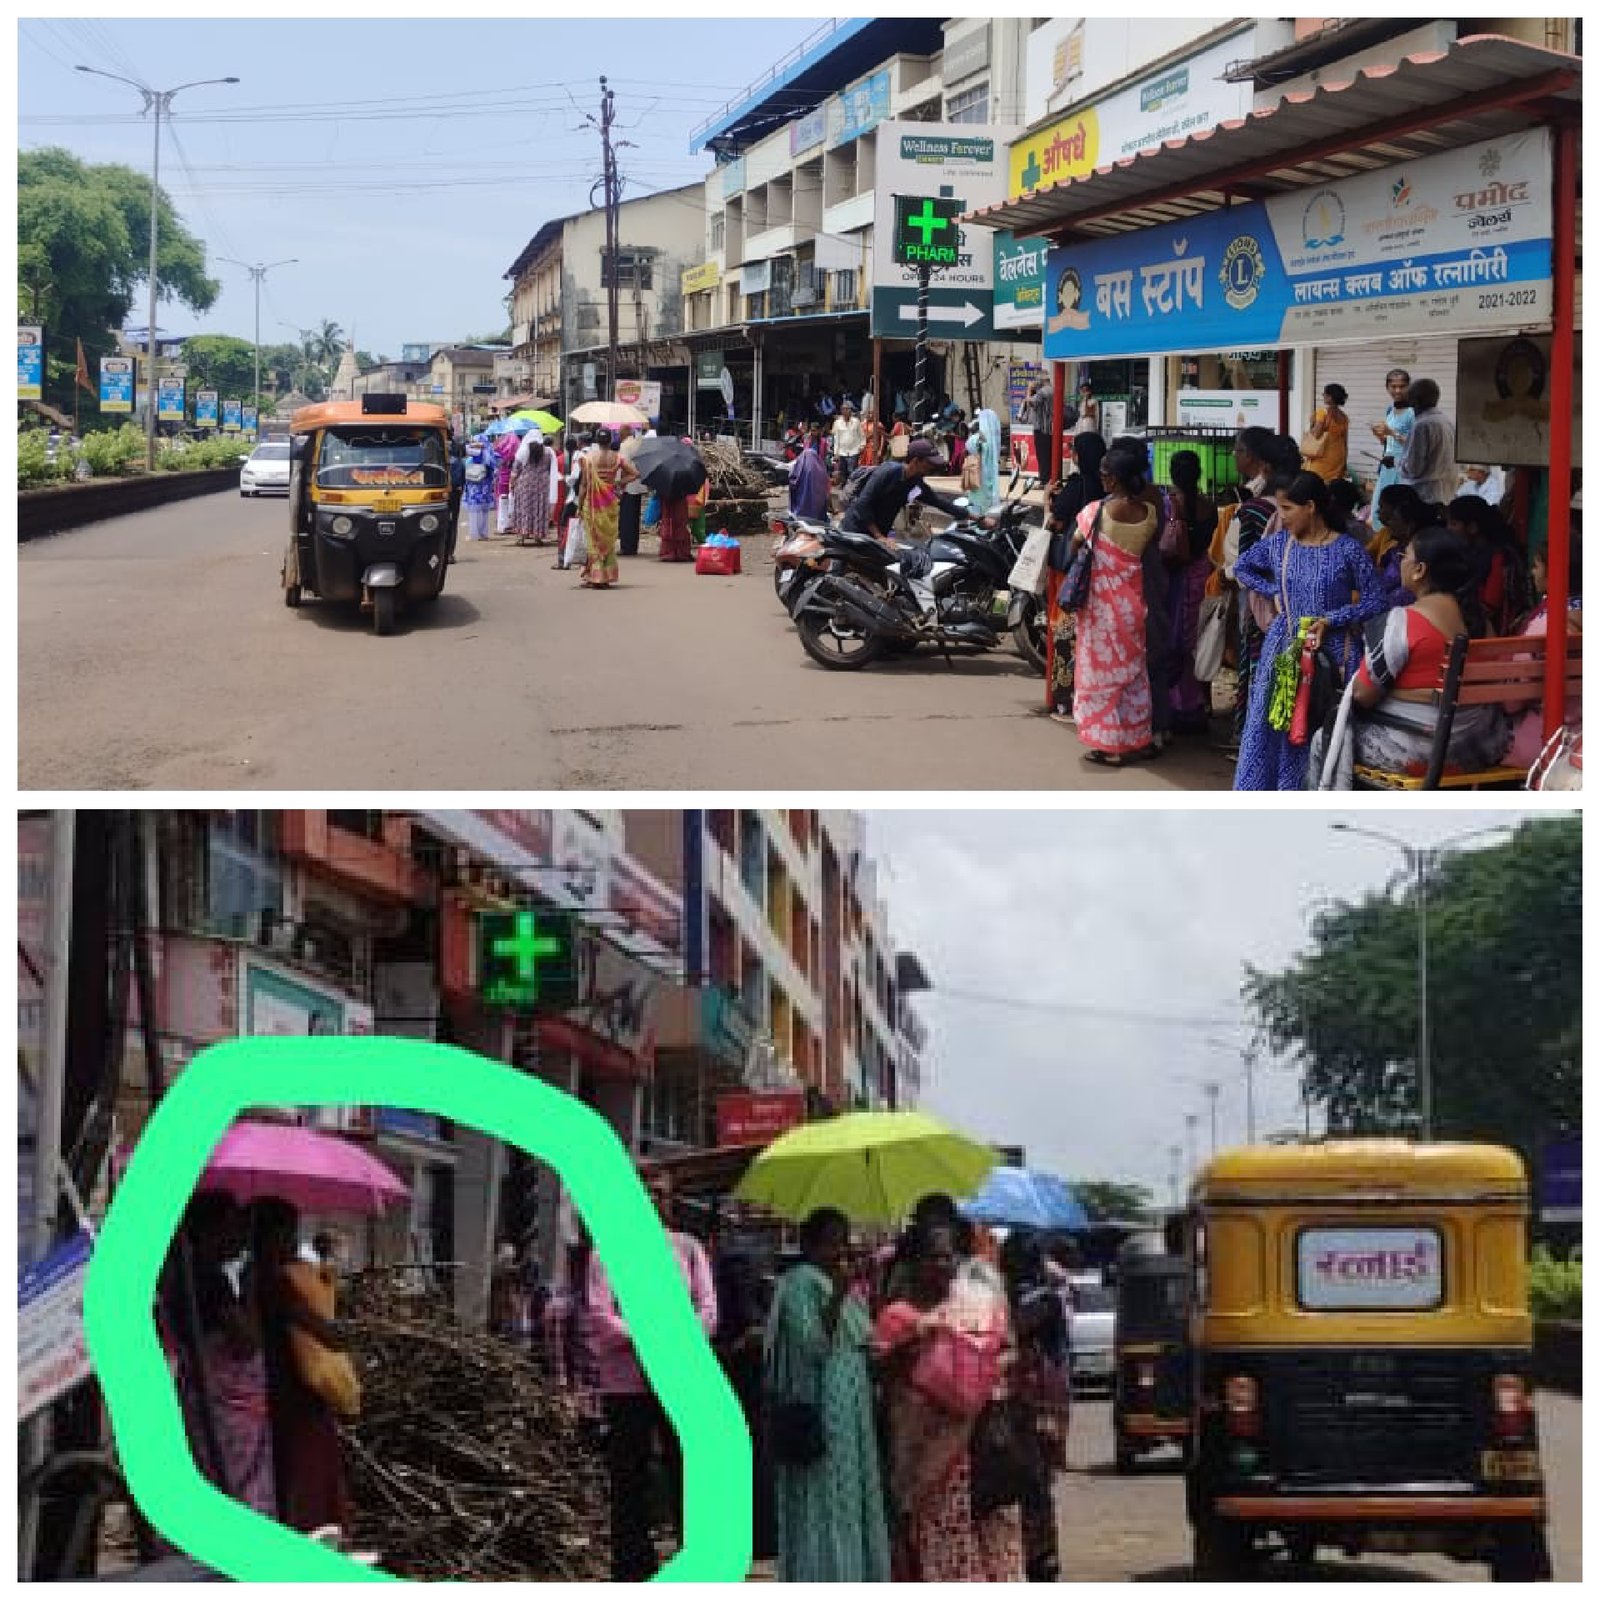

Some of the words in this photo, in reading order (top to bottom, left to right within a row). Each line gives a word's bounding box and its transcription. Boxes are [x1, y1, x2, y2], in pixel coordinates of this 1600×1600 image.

[903, 139, 949, 154] Wellness
[951, 141, 993, 156] Forever
[1042, 120, 1086, 175] औषधे
[950, 274, 986, 283] HOURS
[1000, 246, 1038, 281] वेलनेस
[1094, 270, 1134, 320] बस
[1140, 236, 1205, 317] स्टॉप
[1293, 278, 1340, 302] लायन्स
[1345, 272, 1383, 296] क्लब
[1389, 260, 1427, 290] ऑफ
[1433, 246, 1509, 287] रत्नागिरी
[1478, 290, 1537, 310] 2021-2022
